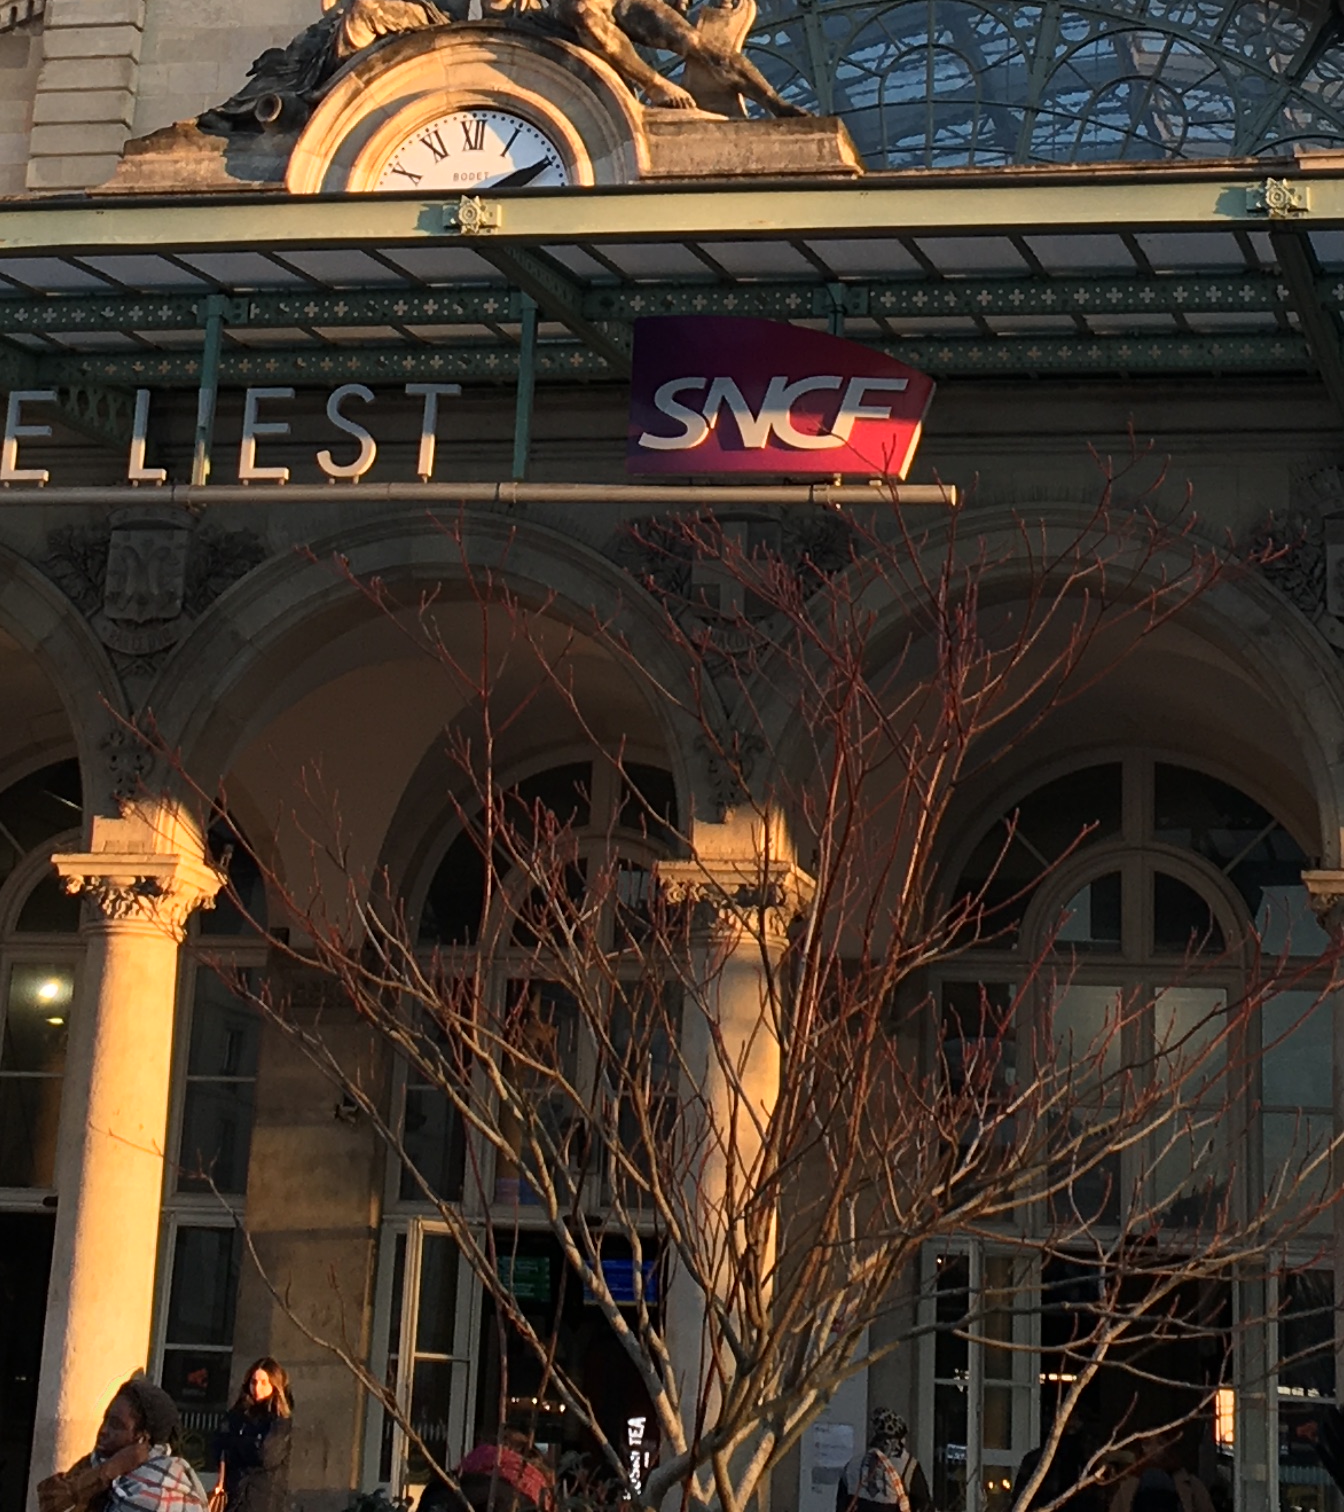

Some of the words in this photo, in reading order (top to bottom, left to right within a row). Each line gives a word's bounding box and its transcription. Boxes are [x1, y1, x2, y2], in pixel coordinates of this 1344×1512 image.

[419, 129, 450, 164] XI
[460, 119, 487, 152] XII
[391, 162, 424, 186] X
[453, 171, 490, 182] BODET
[638, 375, 908, 450] SNCF
[627, 1417, 646, 1446] TEA
